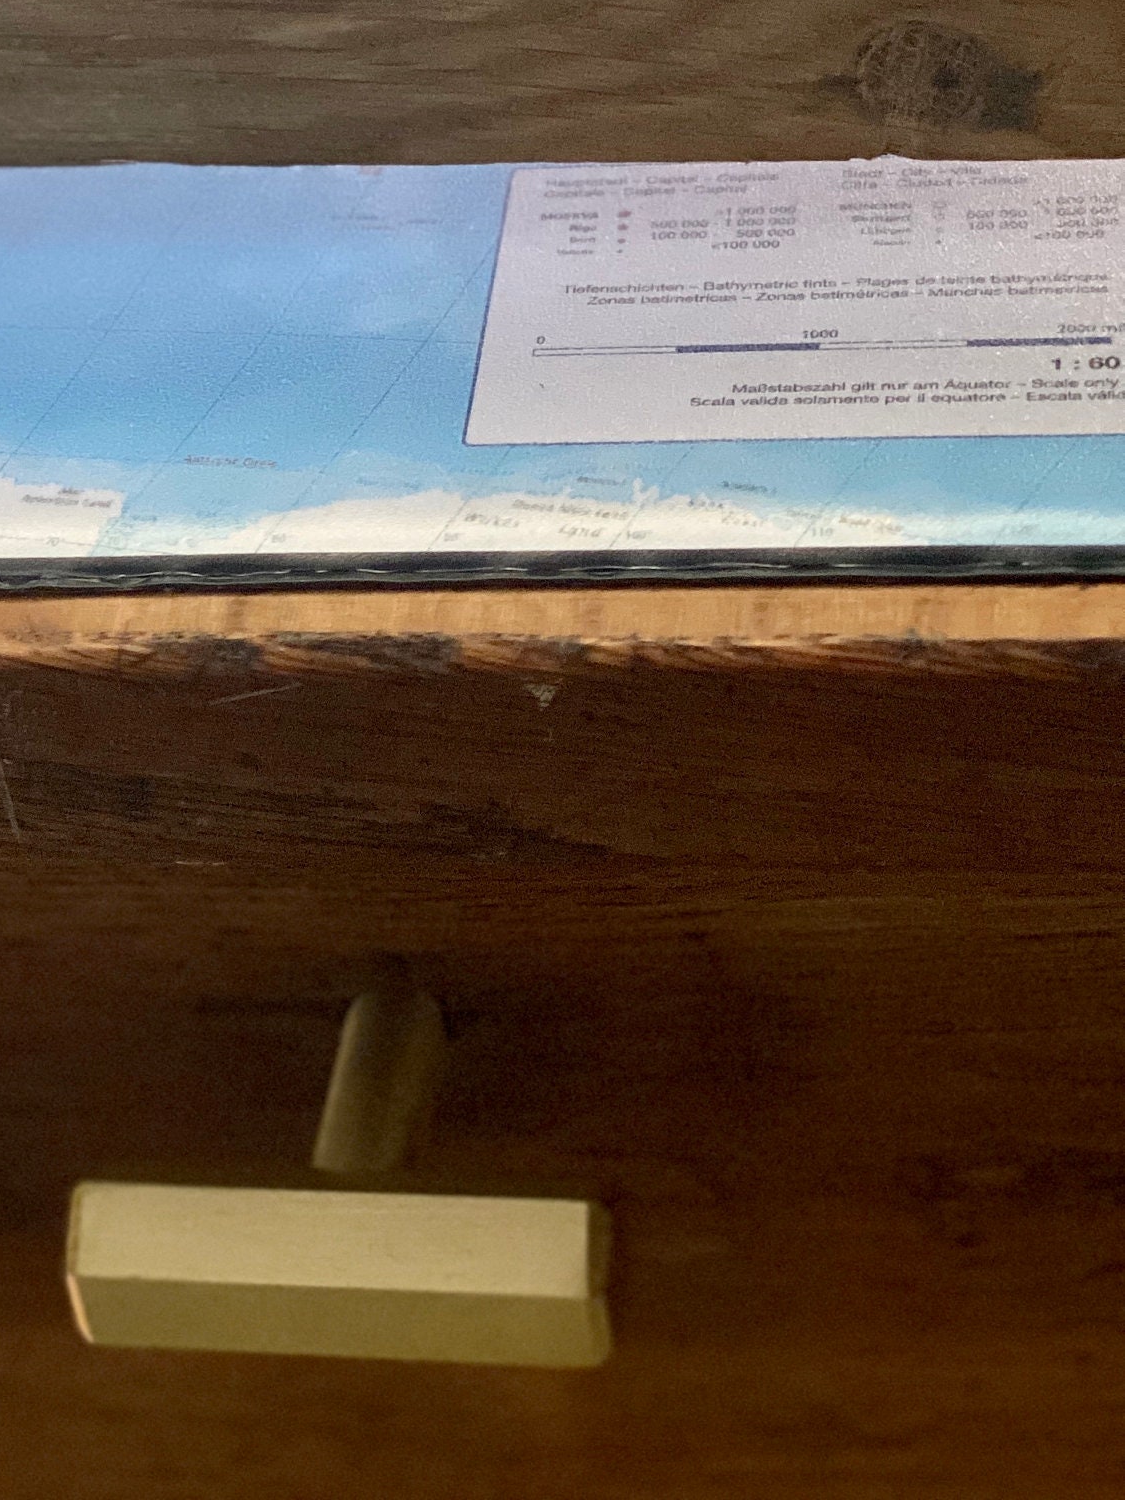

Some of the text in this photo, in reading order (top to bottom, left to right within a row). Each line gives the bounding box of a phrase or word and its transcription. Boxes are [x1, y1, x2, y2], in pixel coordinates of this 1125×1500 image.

[1087, 355, 1121, 370] 60
[732, 382, 846, 393] Maßstabszahl
[851, 382, 875, 395] gilt
[881, 382, 908, 391] nur
[913, 381, 939, 390] am
[1031, 378, 1079, 389] Scale
[1084, 377, 1119, 390] only
[690, 397, 735, 407] Scala
[741, 395, 788, 405] valida
[885, 394, 910, 405] per
[1026, 391, 1082, 402] Escala
